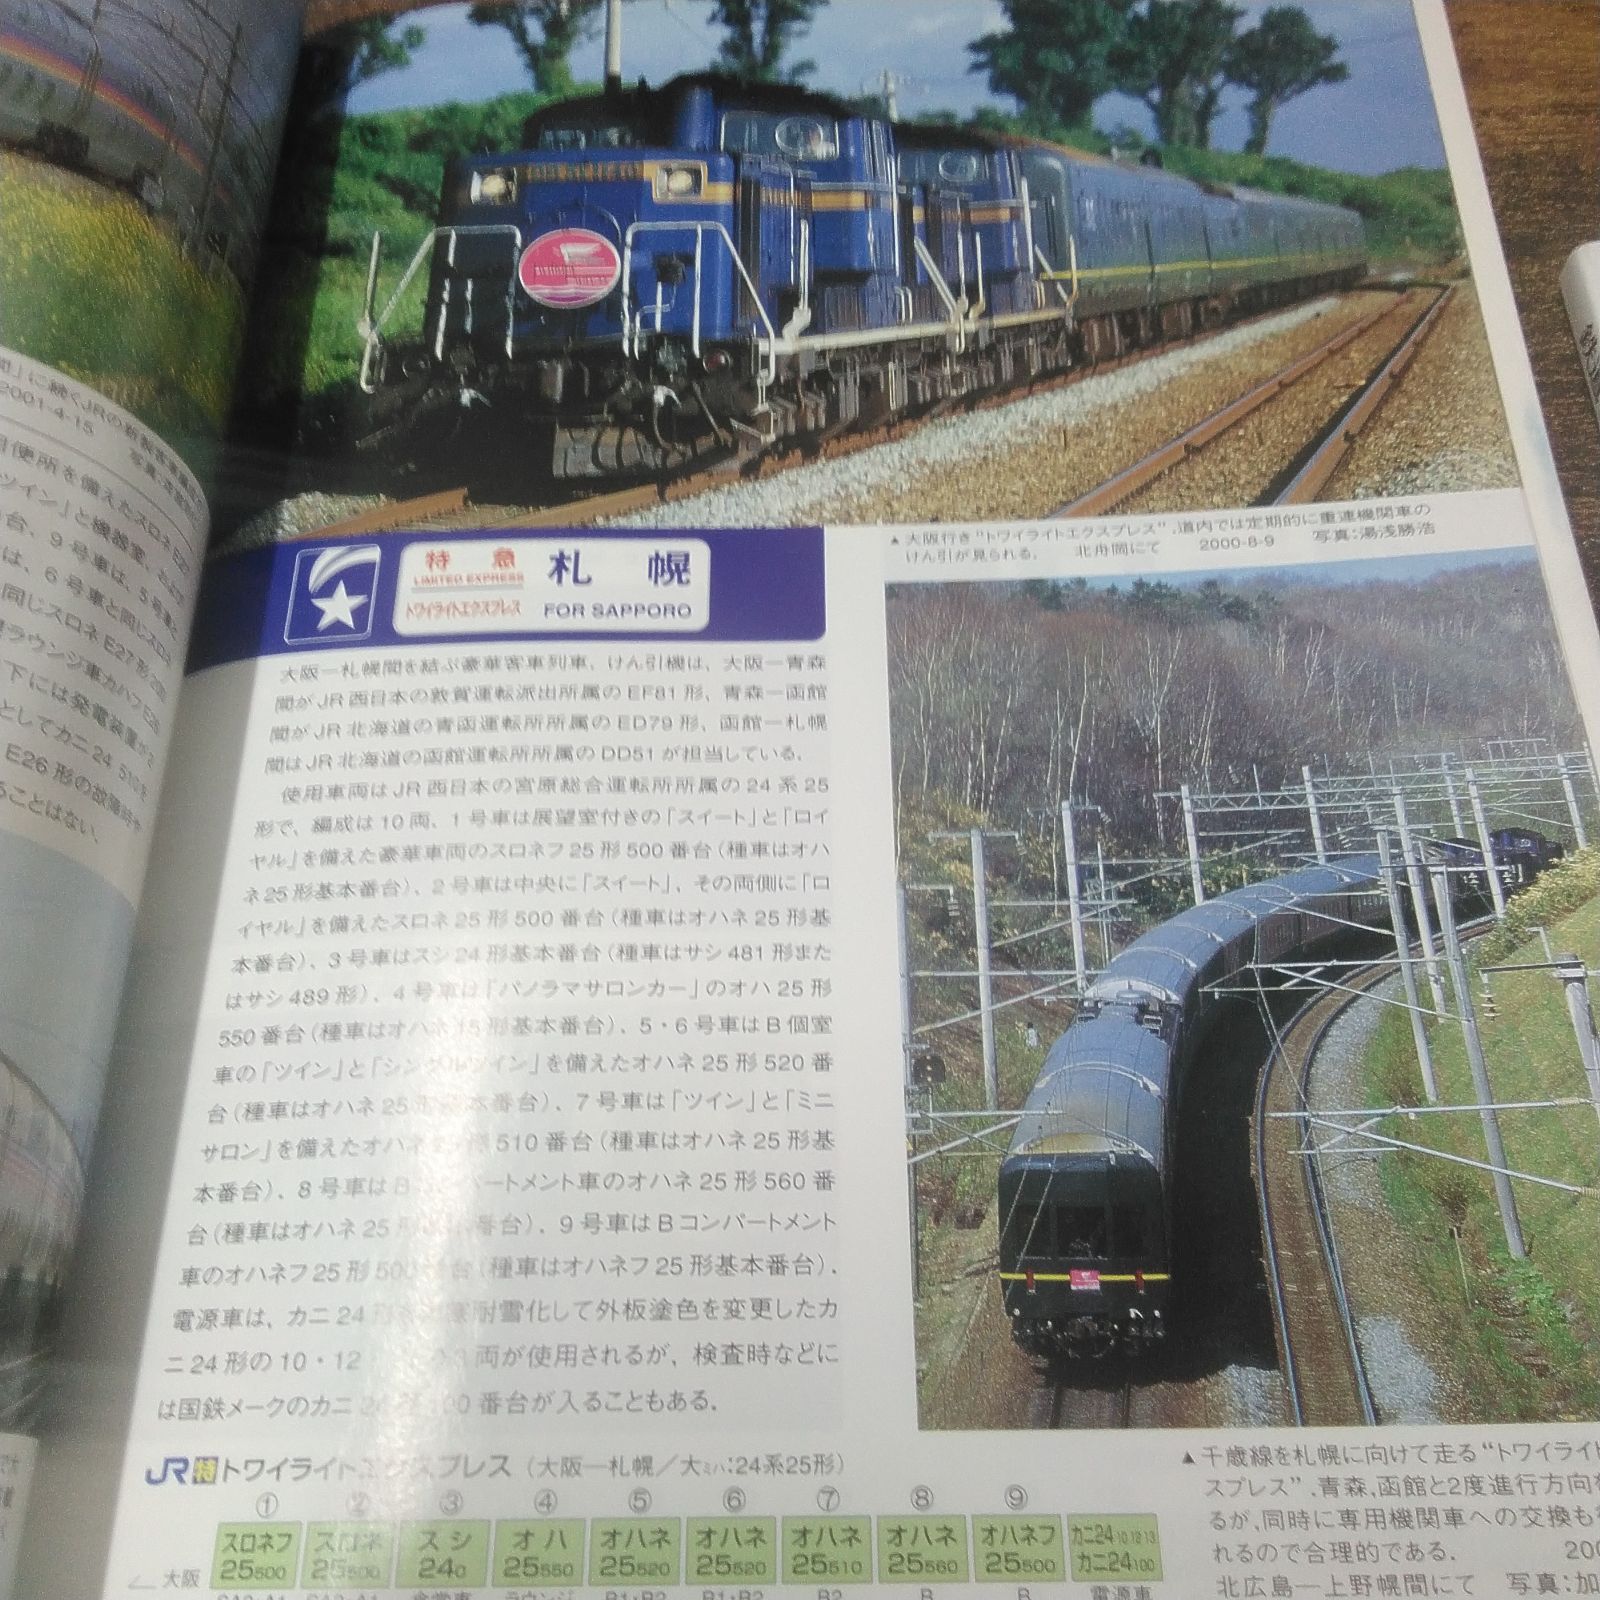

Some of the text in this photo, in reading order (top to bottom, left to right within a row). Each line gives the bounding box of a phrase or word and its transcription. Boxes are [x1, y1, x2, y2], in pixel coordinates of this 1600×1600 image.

[549, 548, 692, 587] 札幌
[543, 602, 692, 619] FOR SAPPORO
[145, 1456, 189, 1485] JR
[222, 1453, 512, 1482] トワイライトプレス
[221, 1531, 293, 1553] スロネフ
[601, 1527, 671, 1550] オハネ
[696, 1526, 768, 1549] オハネ
[791, 1526, 863, 1549] オハネ
[886, 1525, 958, 1548] オハネ
[980, 1524, 1056, 1548] オハネフ
[162, 1568, 201, 1589] 大阪
